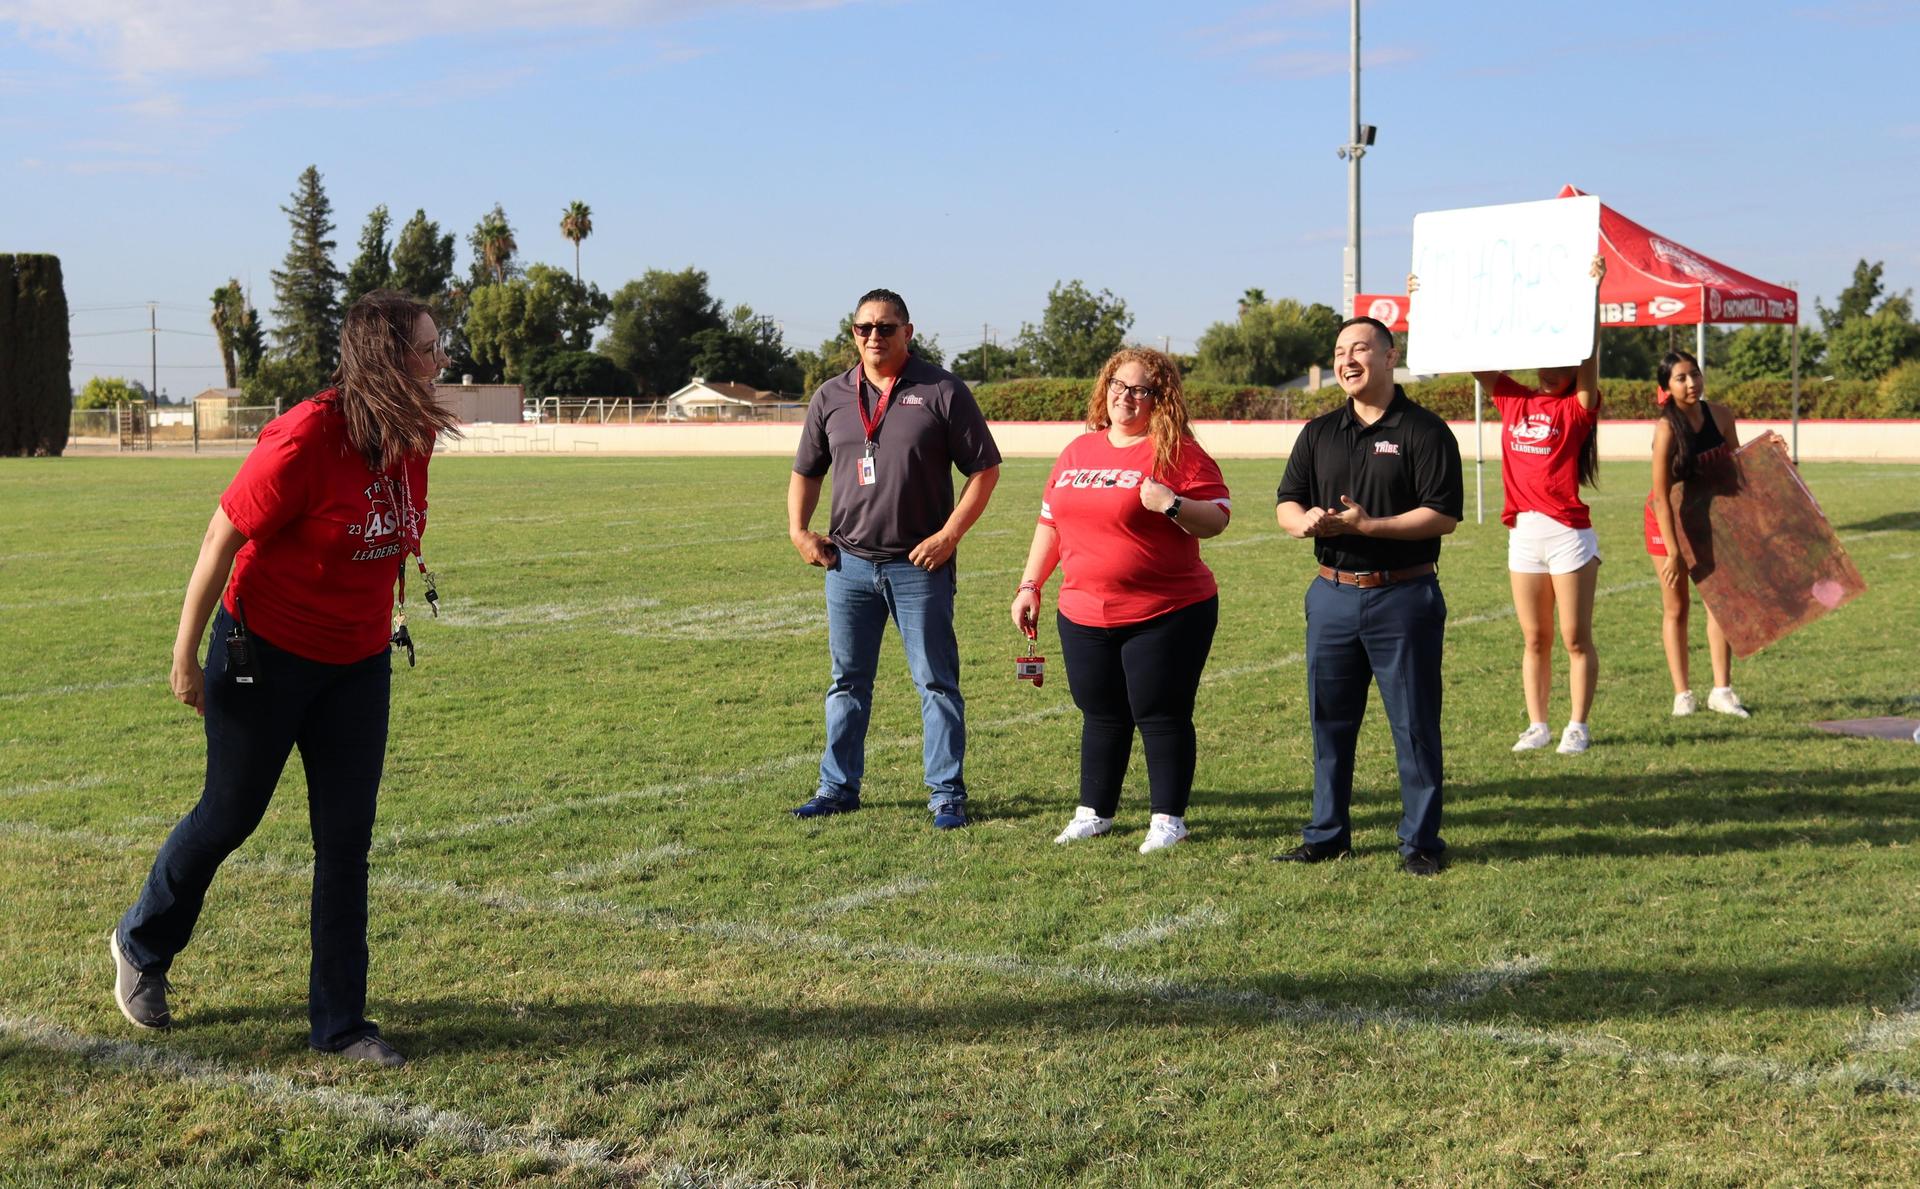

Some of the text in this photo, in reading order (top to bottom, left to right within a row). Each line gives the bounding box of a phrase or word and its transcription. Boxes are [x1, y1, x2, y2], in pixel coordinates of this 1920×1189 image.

[1599, 302, 1637, 323] IBE
[1375, 443, 1399, 453] TRIBE
[1510, 440, 1552, 455] LEADERSHIP
[1055, 468, 1142, 489] CUHS
[364, 510, 402, 537] AS
[351, 543, 400, 561] LEADERS
